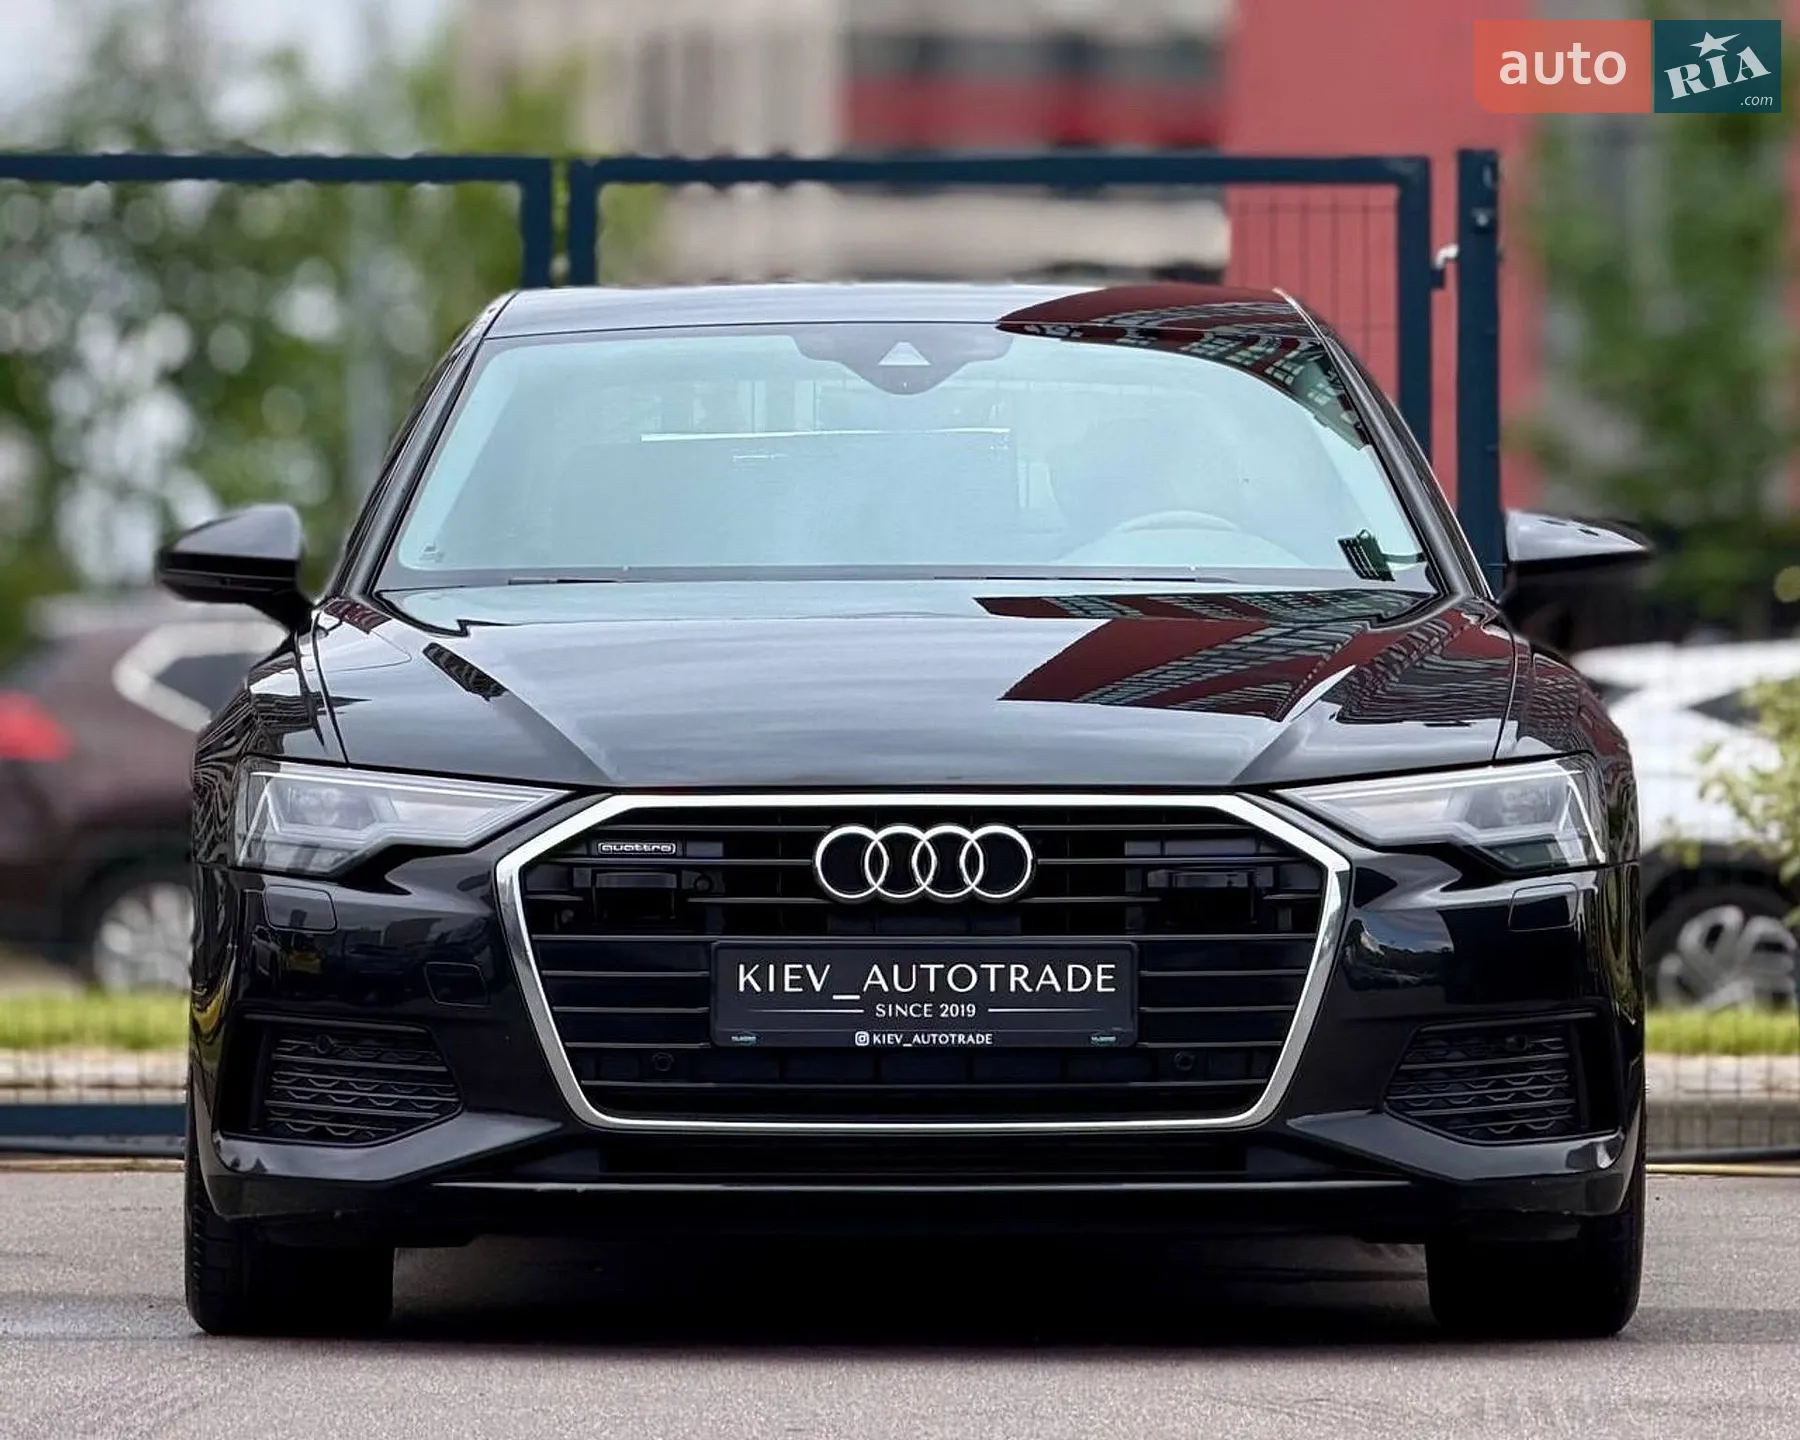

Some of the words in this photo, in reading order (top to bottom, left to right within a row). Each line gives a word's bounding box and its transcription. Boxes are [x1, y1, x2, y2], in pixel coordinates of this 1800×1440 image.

[601, 843, 672, 854] quattro
[737, 963, 1117, 1000] KIEV_AUTOTRADE
[875, 1003, 933, 1019] SINCE
[940, 1003, 976, 1019] 2019
[873, 1033, 994, 1047] KIEV_AUTOTRADE
